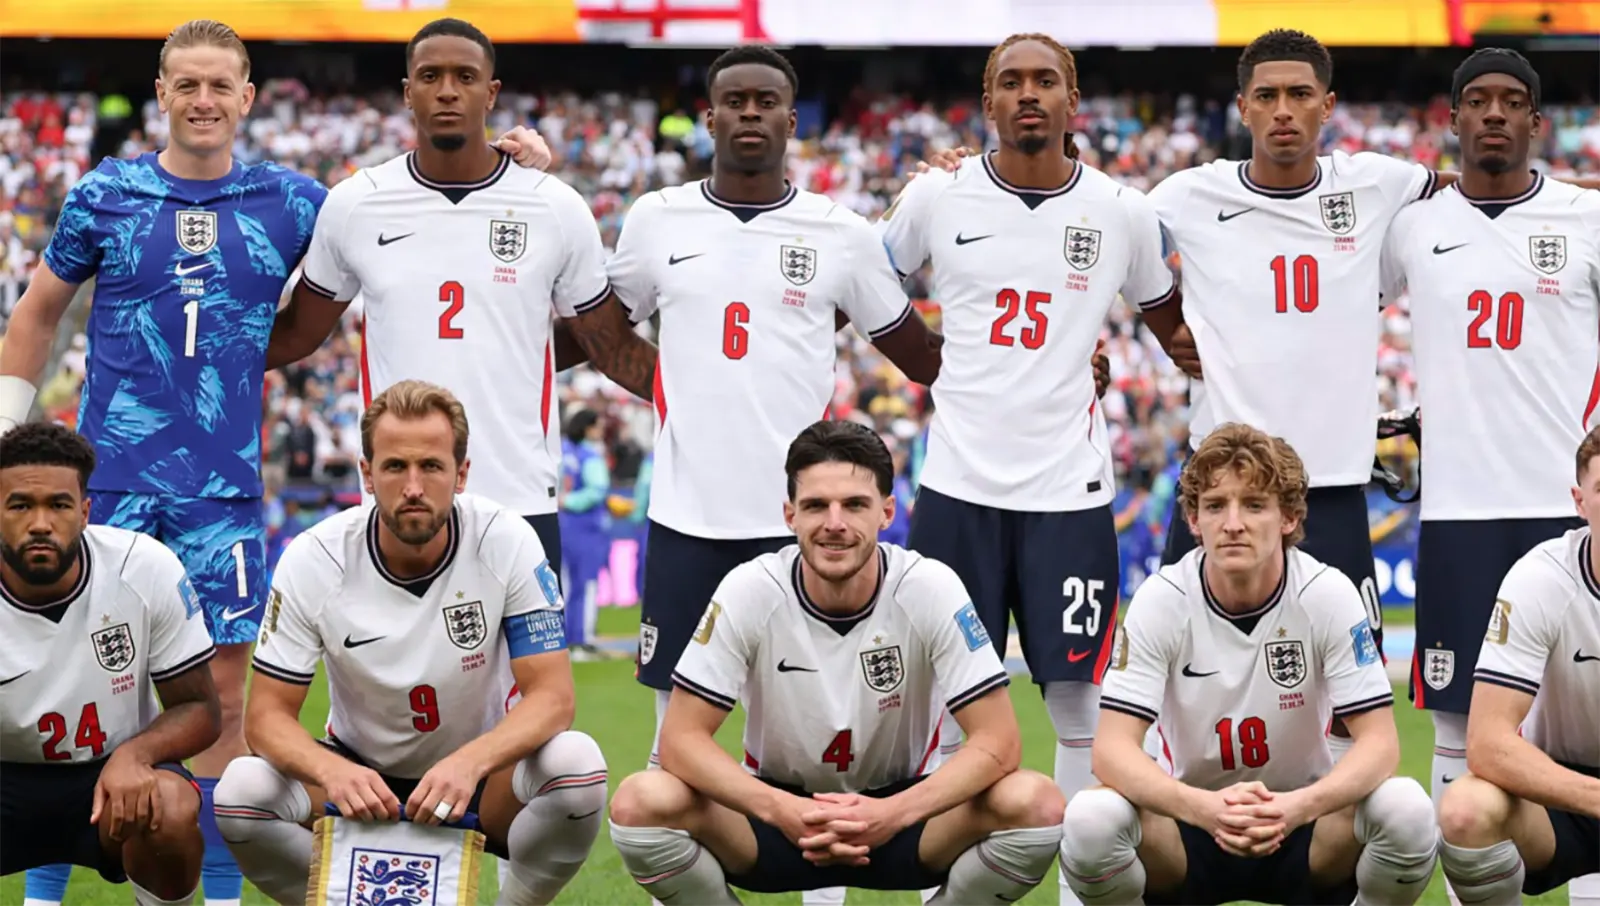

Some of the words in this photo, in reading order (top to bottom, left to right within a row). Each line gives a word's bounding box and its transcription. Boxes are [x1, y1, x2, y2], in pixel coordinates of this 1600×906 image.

[438, 280, 464, 339] 2
[1270, 254, 1319, 314] 10
[183, 300, 199, 357] 1
[722, 301, 750, 360] 6
[989, 288, 1052, 350] 25
[1467, 289, 1525, 350] 20
[231, 541, 248, 598] 1
[527, 617, 562, 633] UNITES
[1062, 576, 1104, 637] 25
[1360, 576, 1381, 631] 0
[111, 673, 134, 686] GHANA
[461, 652, 485, 664] GHANA
[409, 684, 440, 733] 9
[1279, 692, 1303, 701] GHANA
[37, 701, 107, 761] 24
[822, 728, 854, 772] 4
[1215, 716, 1270, 771] 18
